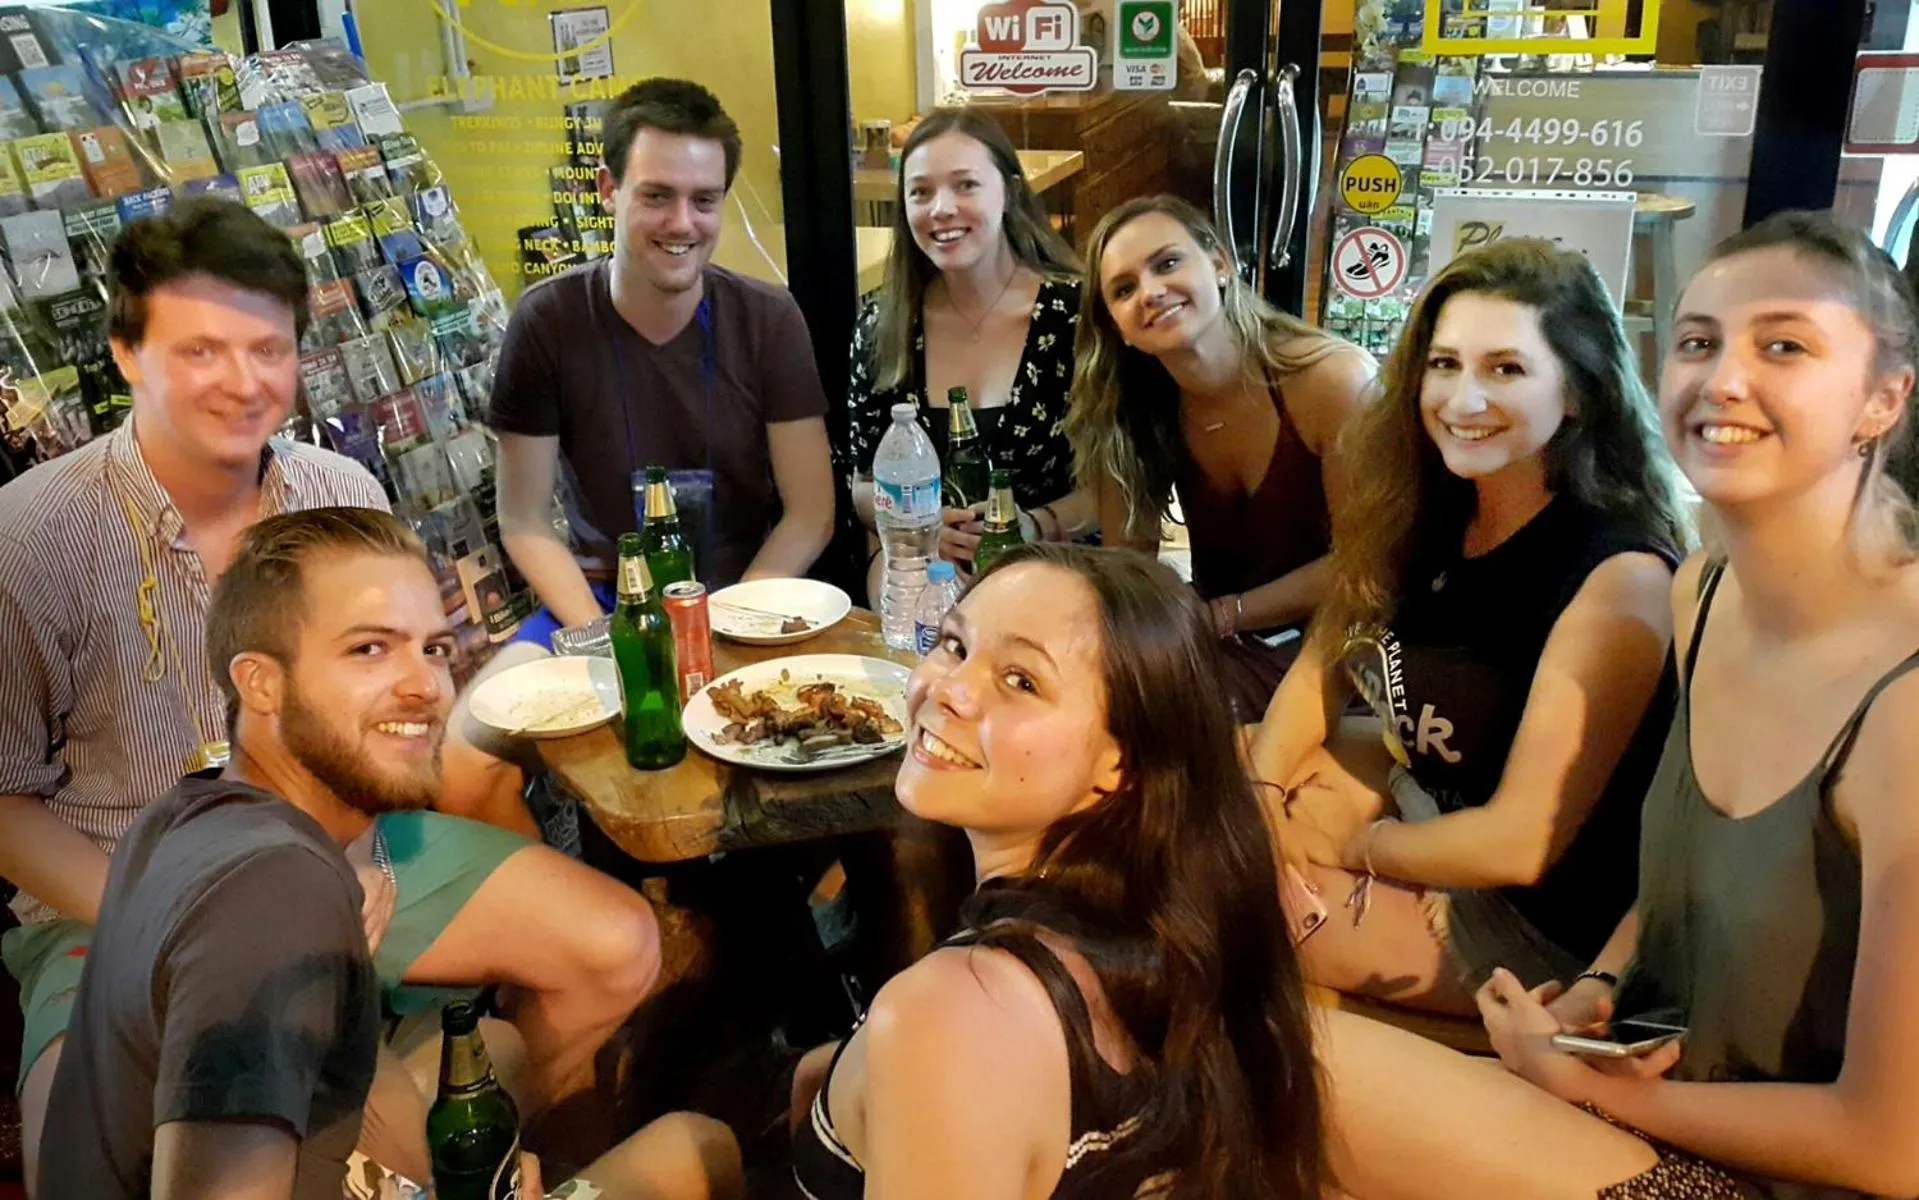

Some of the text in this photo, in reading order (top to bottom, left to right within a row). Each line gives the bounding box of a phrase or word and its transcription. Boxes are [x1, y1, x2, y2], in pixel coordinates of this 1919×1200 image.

[969, 61, 1083, 82] Welcome
[1472, 80, 1581, 98] WELCOME
[1440, 116, 1643, 147] 094-4499-616
[576, 141, 605, 155] ADV
[552, 167, 601, 180] MOUNT
[1438, 155, 1634, 188] 052-017-856
[1345, 176, 1396, 193] PUSH
[579, 192, 601, 204] INT
[576, 216, 615, 229] SIGHT
[524, 239, 559, 251] NECK
[1387, 641, 1408, 712] PLANET
